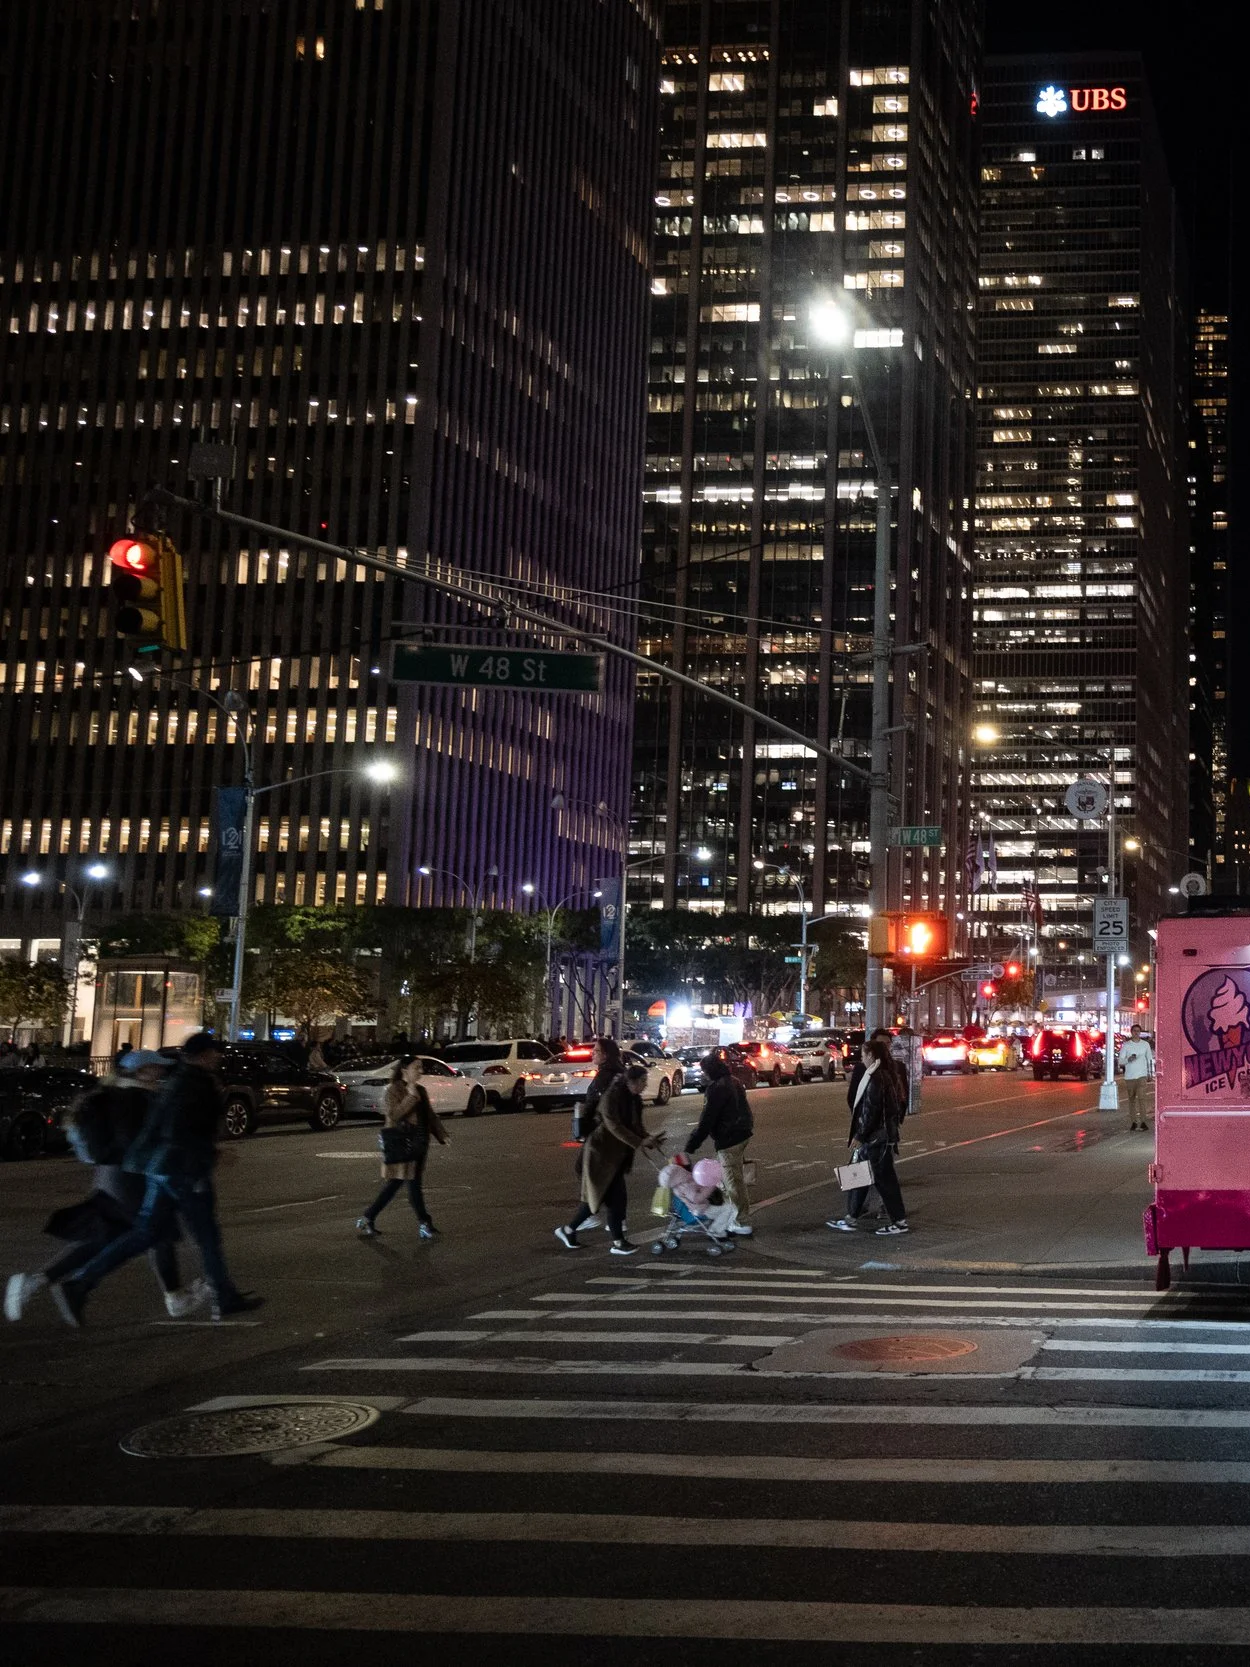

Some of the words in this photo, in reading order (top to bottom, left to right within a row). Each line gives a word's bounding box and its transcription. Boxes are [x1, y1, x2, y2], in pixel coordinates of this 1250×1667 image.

[1070, 87, 1127, 111] UBS
[450, 654, 470, 679] W
[478, 655, 510, 681] 48
[521, 658, 548, 682] St
[902, 829, 912, 845] W
[913, 829, 927, 844] 48
[928, 829, 939, 838] ST
[1099, 921, 1124, 936] 25
[1205, 1077, 1226, 1094] ICE
